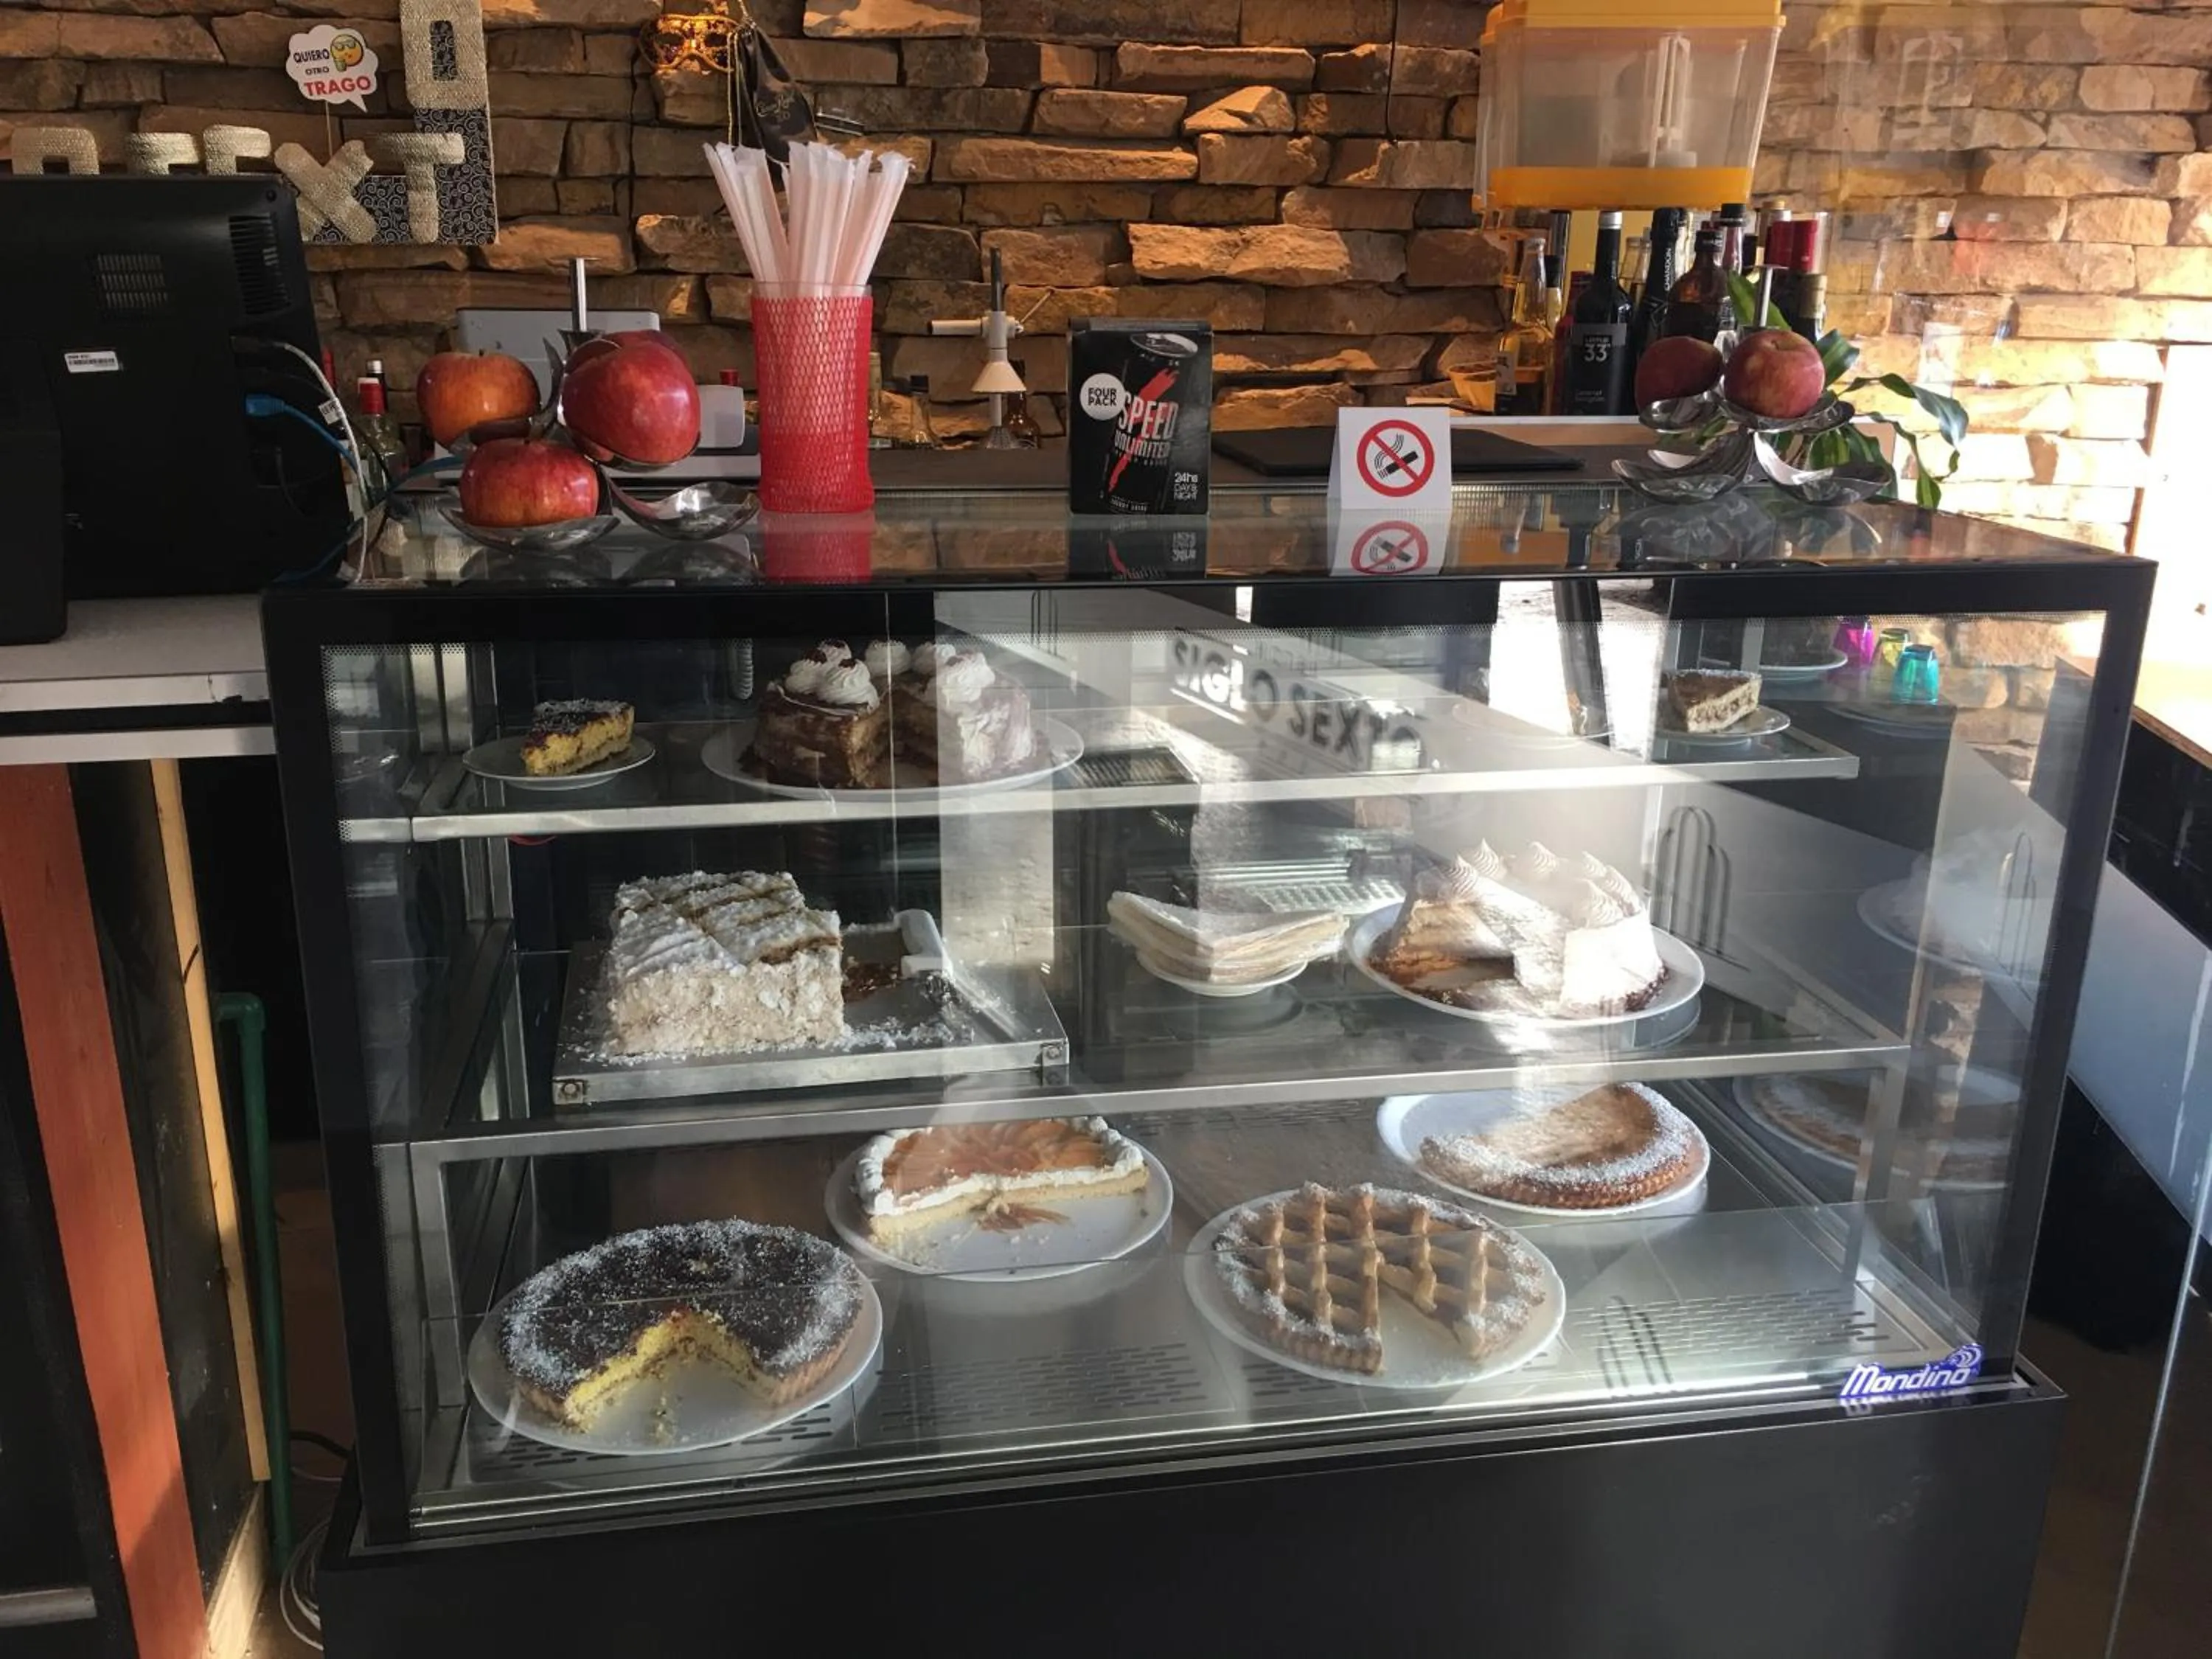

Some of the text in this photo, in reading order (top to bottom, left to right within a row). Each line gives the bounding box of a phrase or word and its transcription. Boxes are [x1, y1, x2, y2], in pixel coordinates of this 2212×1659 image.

[293, 48, 330, 63] QUIERO
[305, 66, 330, 75] OTRO
[304, 75, 371, 96] TRAGO
[1663, 248, 1672, 291] CHANDON
[1088, 387, 1117, 397] FOUR
[1088, 396, 1117, 406] PACK
[1118, 391, 1179, 440] SPEED
[1174, 472, 1198, 483] 24hs
[1840, 1363, 1971, 1397] Mondino
